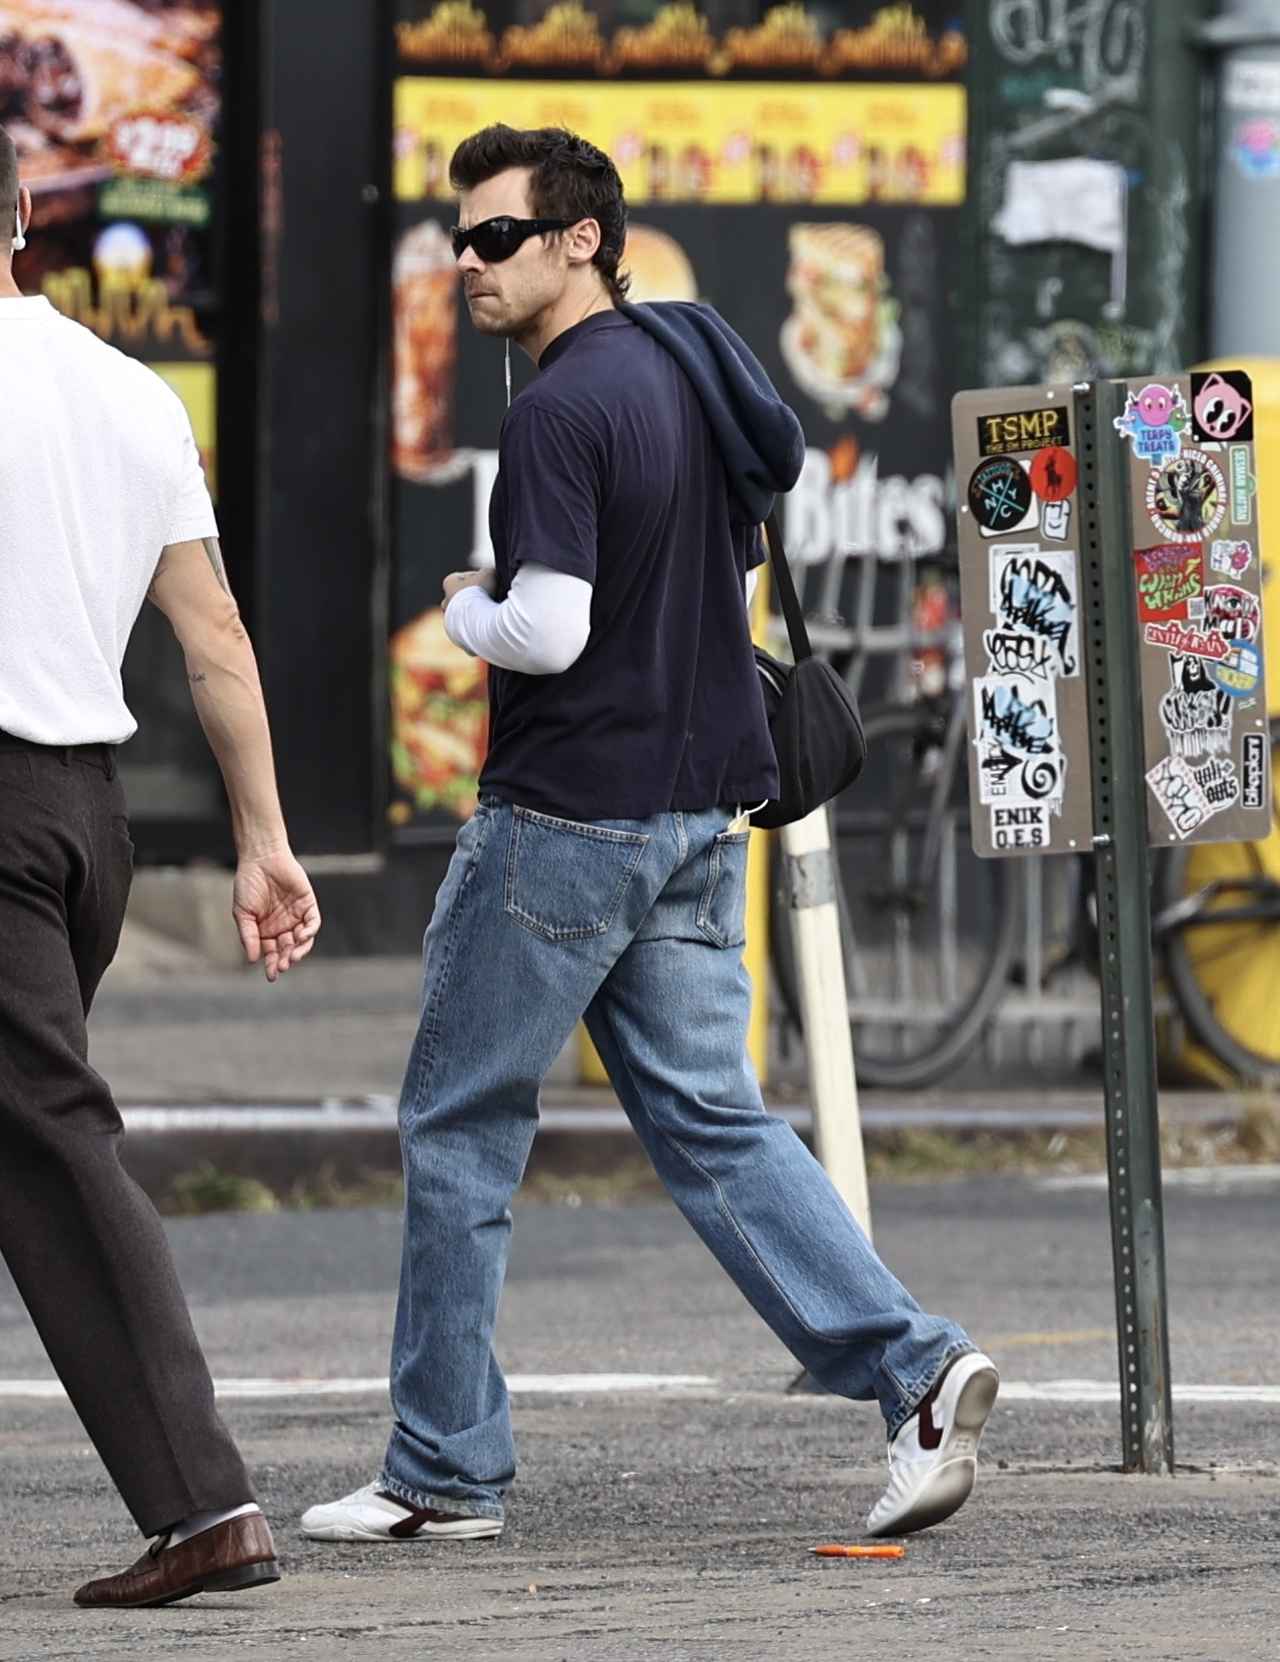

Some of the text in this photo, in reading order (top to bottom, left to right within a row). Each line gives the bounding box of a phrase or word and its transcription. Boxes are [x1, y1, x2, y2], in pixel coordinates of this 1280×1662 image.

[986, 410, 1059, 443] TSMP
[991, 479, 1017, 500] H Y
[984, 496, 1012, 518] N C
[994, 806, 1043, 827] ENIK
